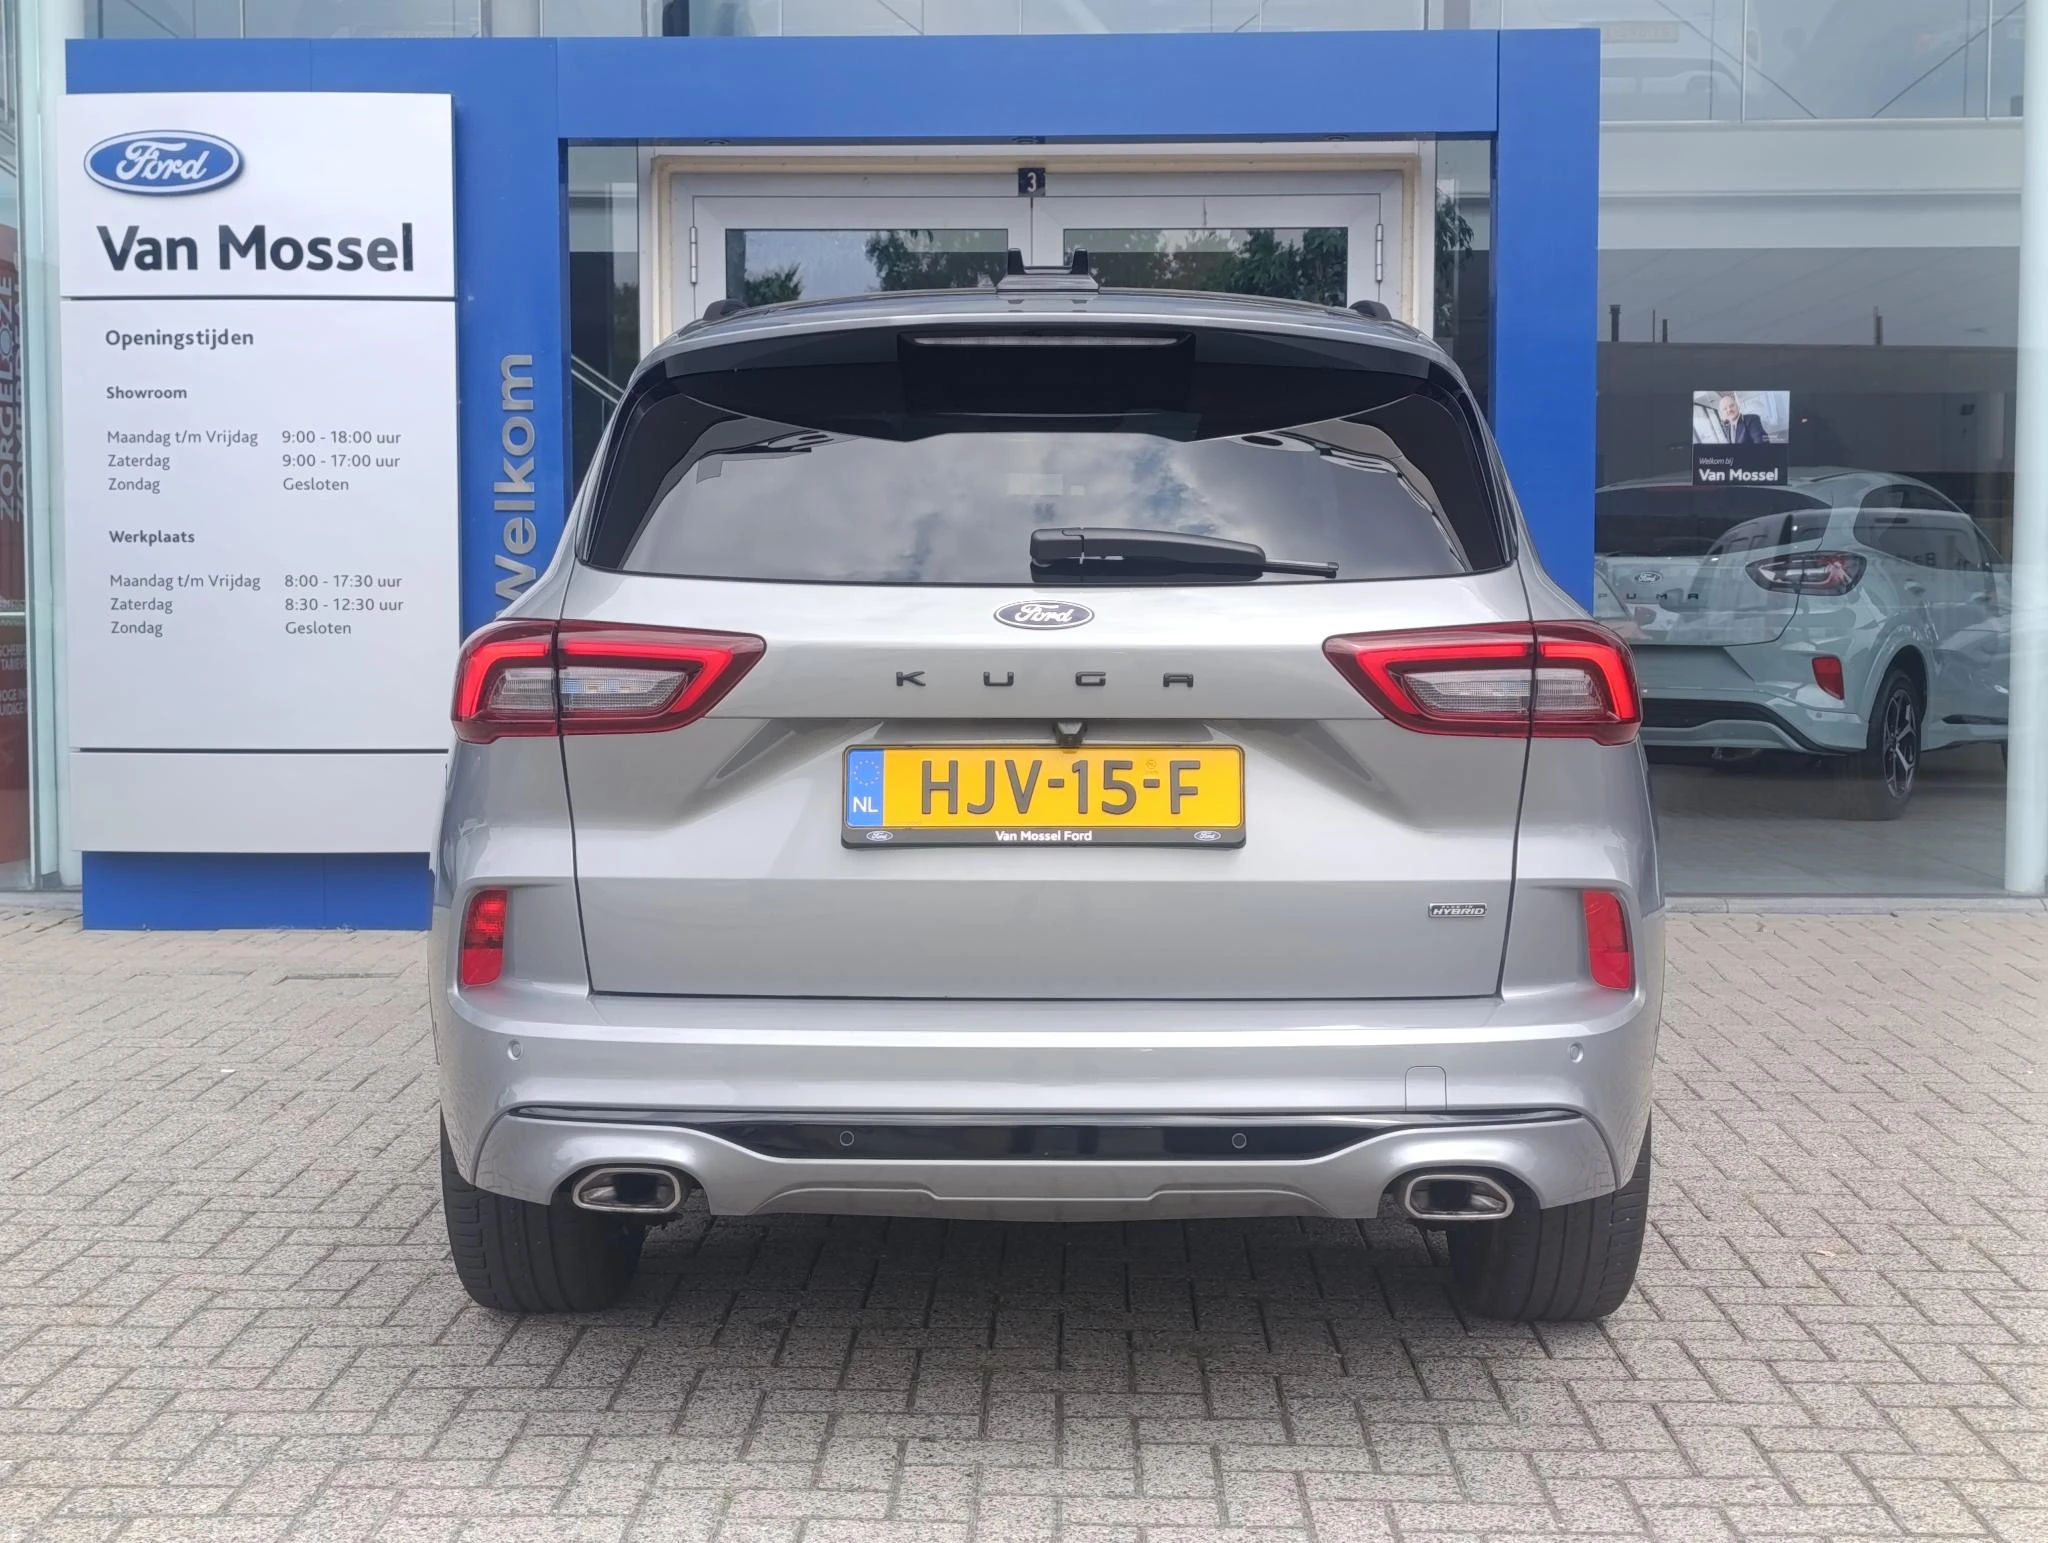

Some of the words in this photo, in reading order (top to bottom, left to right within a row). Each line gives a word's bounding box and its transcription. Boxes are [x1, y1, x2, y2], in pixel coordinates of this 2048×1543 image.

[115, 140, 211, 181] Ford
[1027, 171, 1037, 192] 3
[96, 225, 198, 272] Van
[219, 222, 414, 272] Mossel
[105, 328, 254, 352] Openingstijden
[107, 386, 188, 400] Showroom
[107, 430, 171, 448] Maandag
[175, 430, 201, 444] t/m
[206, 430, 259, 448] Vrijdag
[281, 431, 316, 444] 9:00
[330, 431, 372, 444] 18:00
[376, 434, 402, 444] uur
[107, 454, 171, 471] Zaterdag
[282, 454, 316, 467] 9:00
[330, 454, 372, 467] 17:00
[375, 457, 401, 468] uur
[1699, 468, 1726, 481] Van
[1729, 467, 1779, 481] Mossel
[107, 477, 161, 495] Zondag
[282, 477, 349, 491] Gesloten
[108, 530, 196, 548] Werkplaats
[110, 574, 174, 592] Maandag
[177, 574, 203, 588] t/m
[208, 574, 261, 592] Vrijdag
[284, 575, 319, 588] 8:00
[333, 575, 374, 588] 17:30
[377, 577, 403, 588] uur
[110, 598, 174, 615] Zaterdag
[284, 598, 319, 611] 8:30
[333, 598, 375, 611] 12:30
[379, 601, 405, 612] uur
[110, 621, 164, 638] Zondag
[285, 621, 352, 635] Gesloten
[896, 671, 1194, 688] KUGA
[921, 760, 1201, 815] HJV-15-F
[852, 797, 878, 813] NL
[995, 830, 1018, 841] Van
[1020, 830, 1061, 841] Mossel
[1064, 830, 1093, 841] Ford
